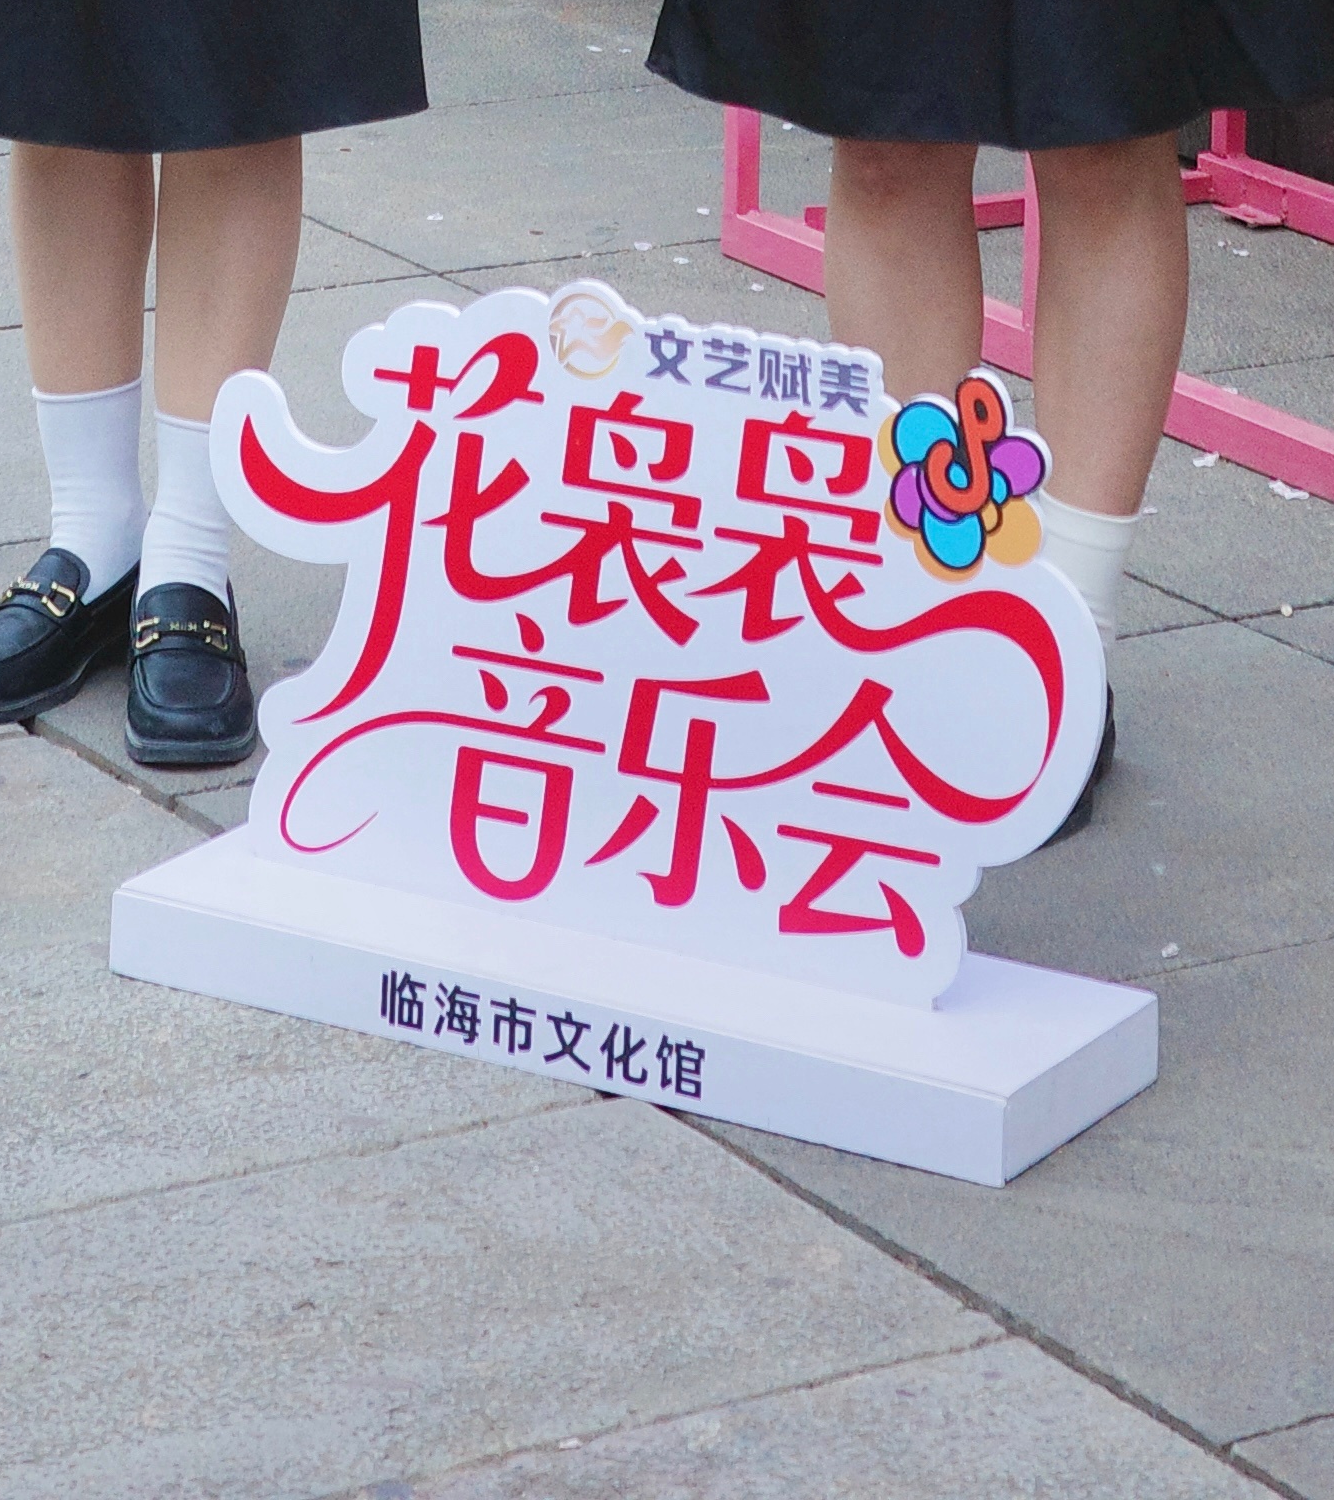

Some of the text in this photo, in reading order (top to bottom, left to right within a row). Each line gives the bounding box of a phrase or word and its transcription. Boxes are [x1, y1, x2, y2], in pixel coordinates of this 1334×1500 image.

[644, 329, 868, 417] 文艺赋美
[240, 332, 1064, 725] 花袅袅
[280, 613, 957, 958] 音乐会
[380, 970, 705, 1100] 临海市文化馆
